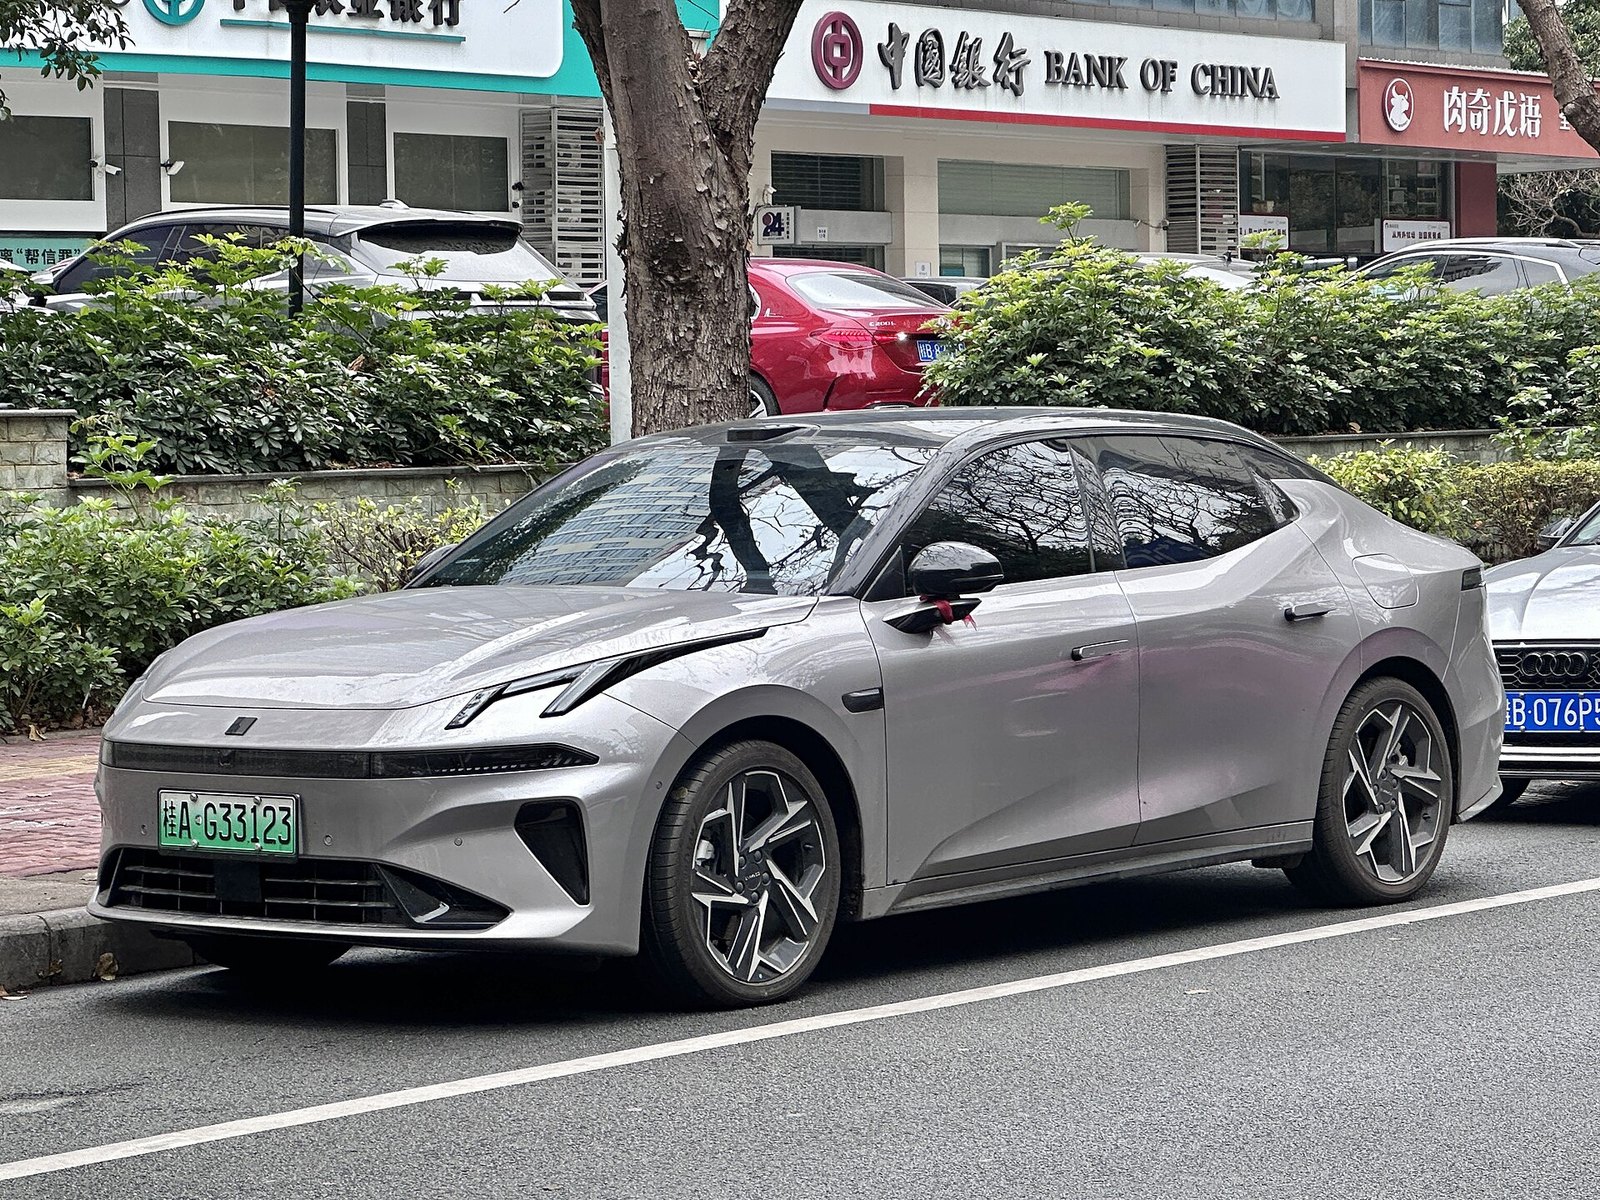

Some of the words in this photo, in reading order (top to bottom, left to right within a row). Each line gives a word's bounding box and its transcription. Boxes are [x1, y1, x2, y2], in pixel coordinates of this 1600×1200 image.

[1043, 50, 1129, 90] BANK
[1140, 58, 1178, 93] OF
[1190, 62, 1281, 100] CHINA
[762, 211, 785, 237] 24
